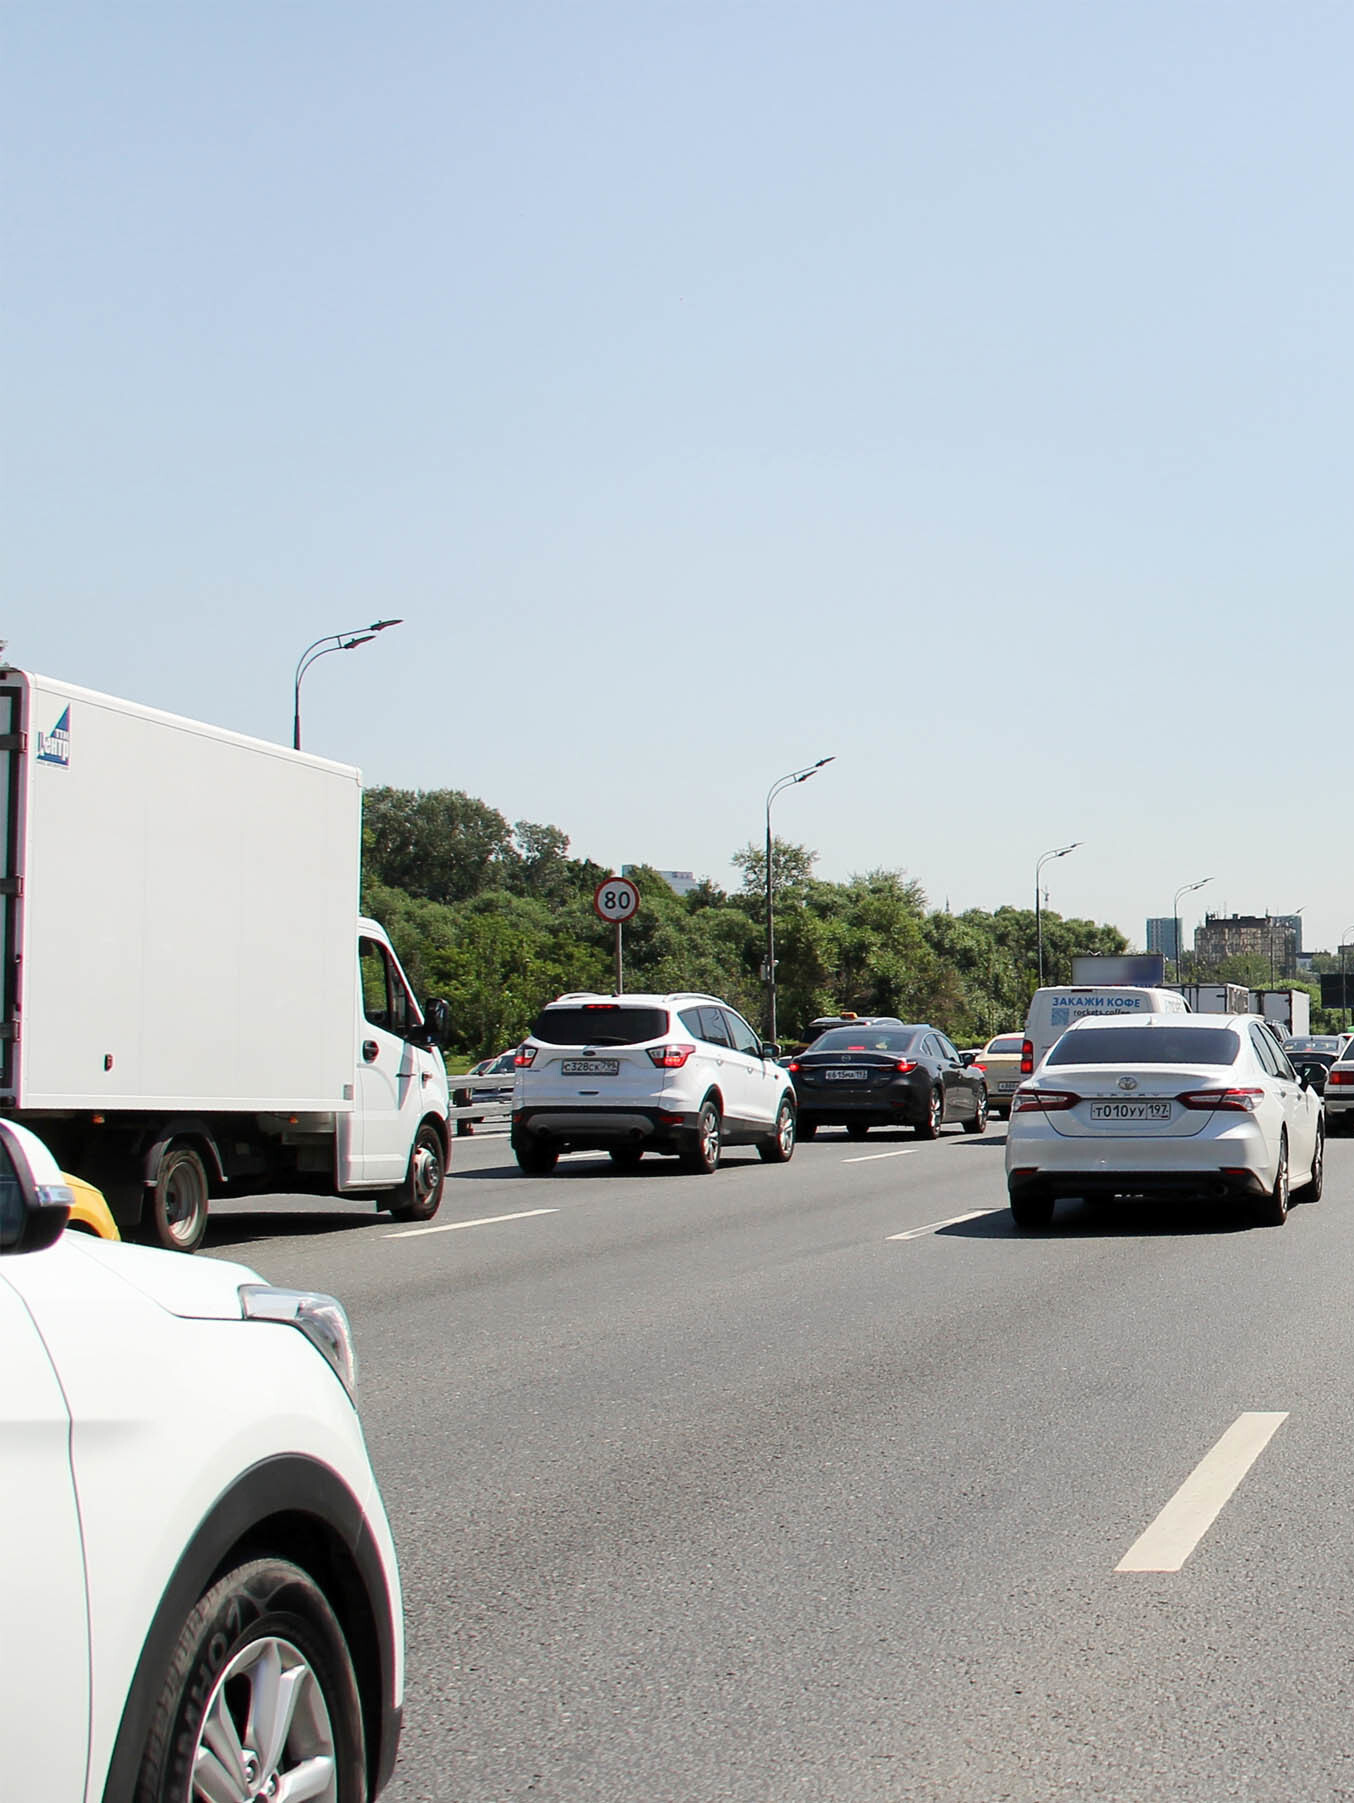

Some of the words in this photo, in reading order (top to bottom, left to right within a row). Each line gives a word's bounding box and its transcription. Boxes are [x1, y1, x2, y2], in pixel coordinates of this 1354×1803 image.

[605, 891, 630, 909] 80
[1053, 997, 1104, 1006] ЗАКАЖИ
[1107, 998, 1140, 1008] КОФЕ
[1096, 1104, 1145, 1118] Т010УУ
[1148, 1104, 1167, 1115] 197
